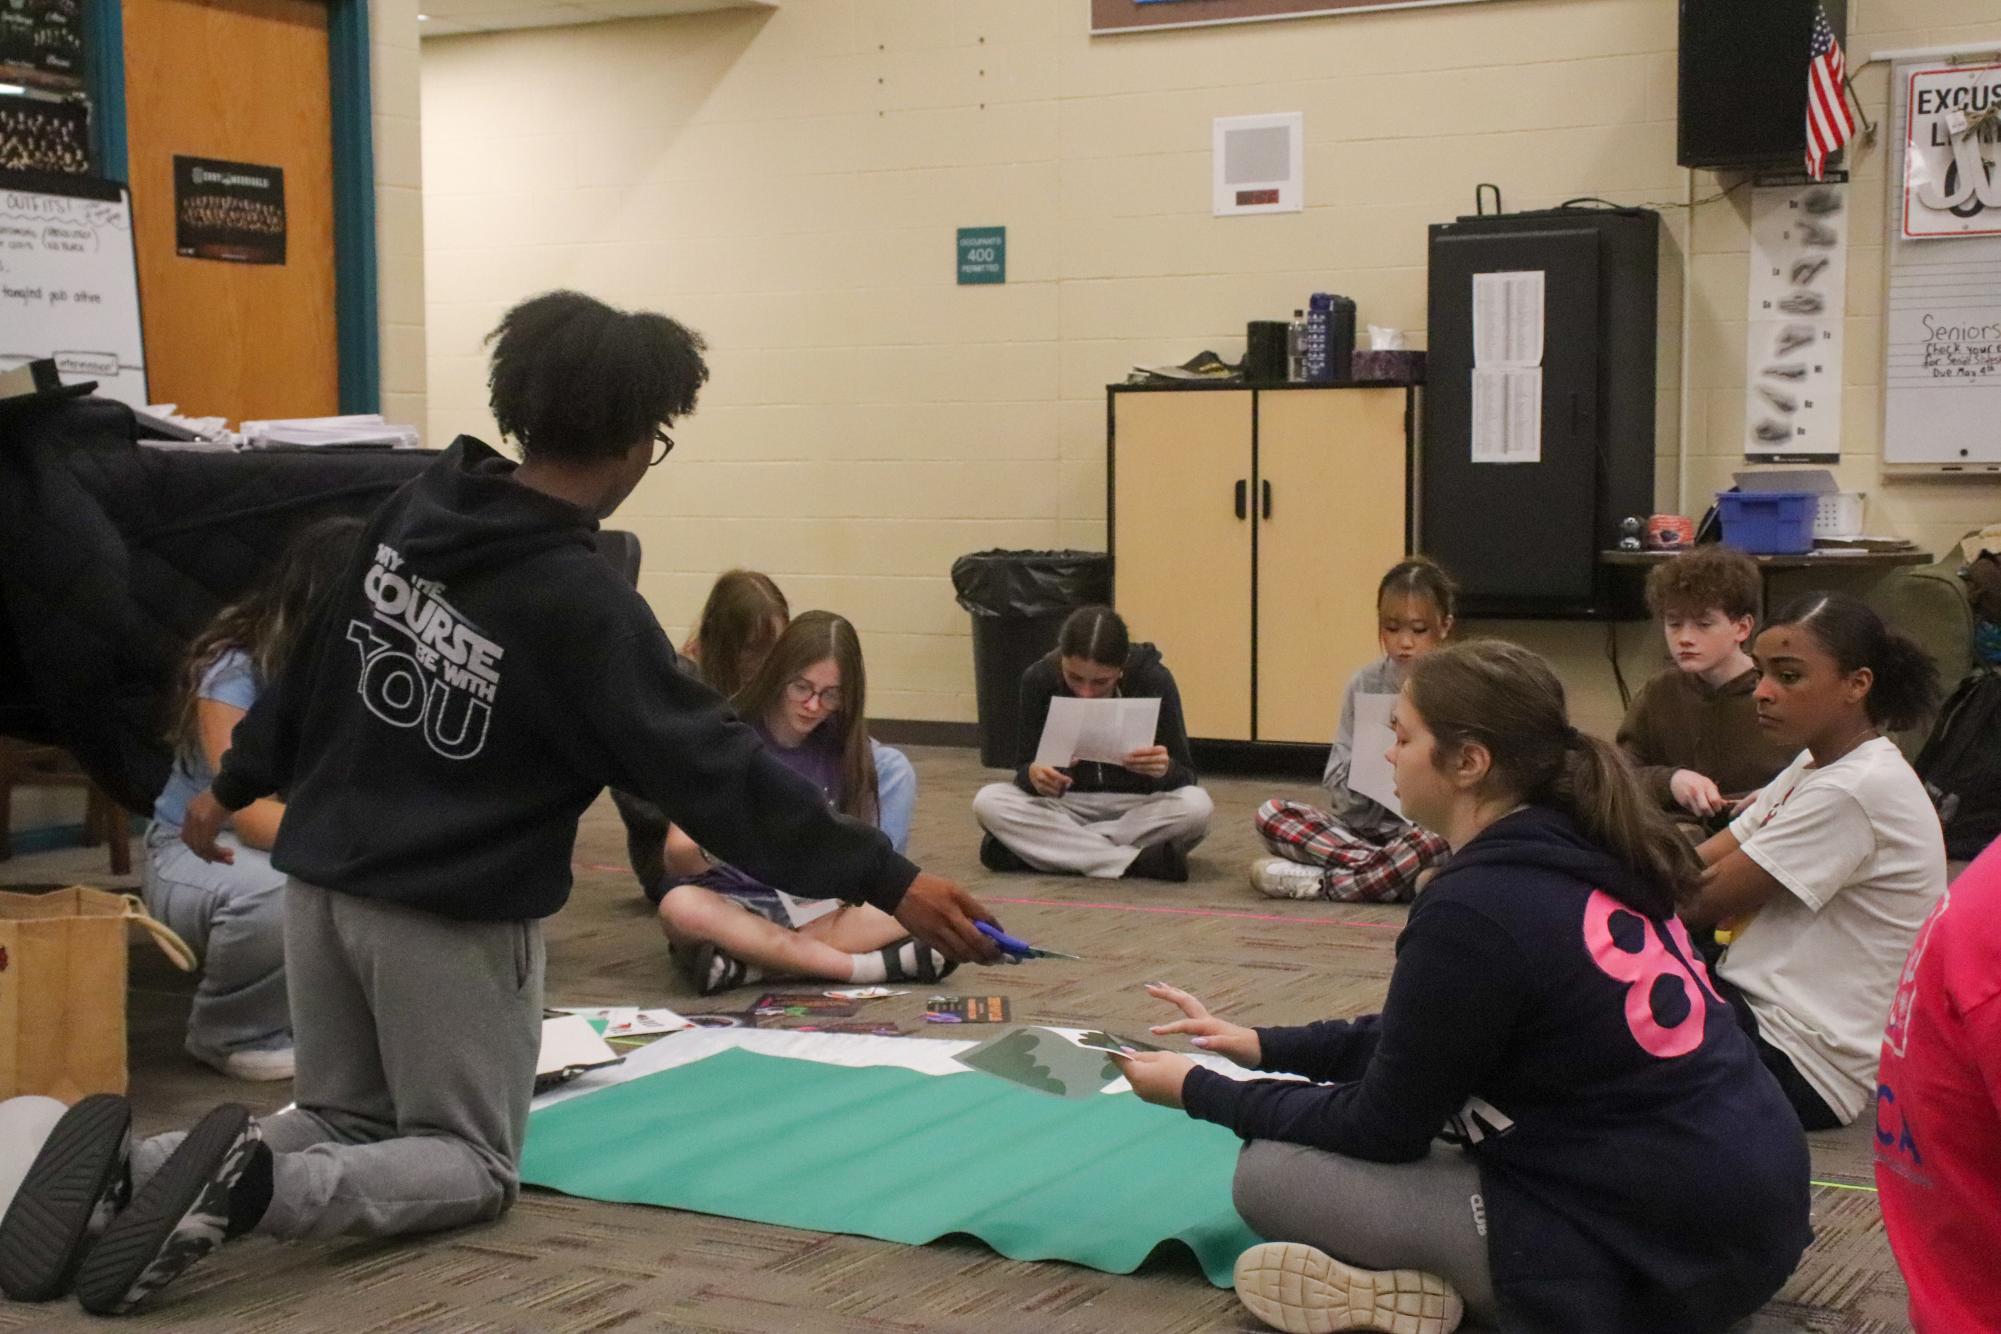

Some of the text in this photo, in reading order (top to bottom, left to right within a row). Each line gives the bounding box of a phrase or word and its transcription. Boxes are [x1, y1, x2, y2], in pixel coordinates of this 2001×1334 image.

[967, 248, 994, 262] 400
[1921, 313, 2001, 343] Seniors
[1924, 353, 1941, 368] for
[1926, 342, 1960, 355] Check
[1966, 344, 1993, 361] your
[1933, 367, 1953, 377] Due
[346, 618, 492, 760] YOU
[443, 658, 497, 704] WITH
